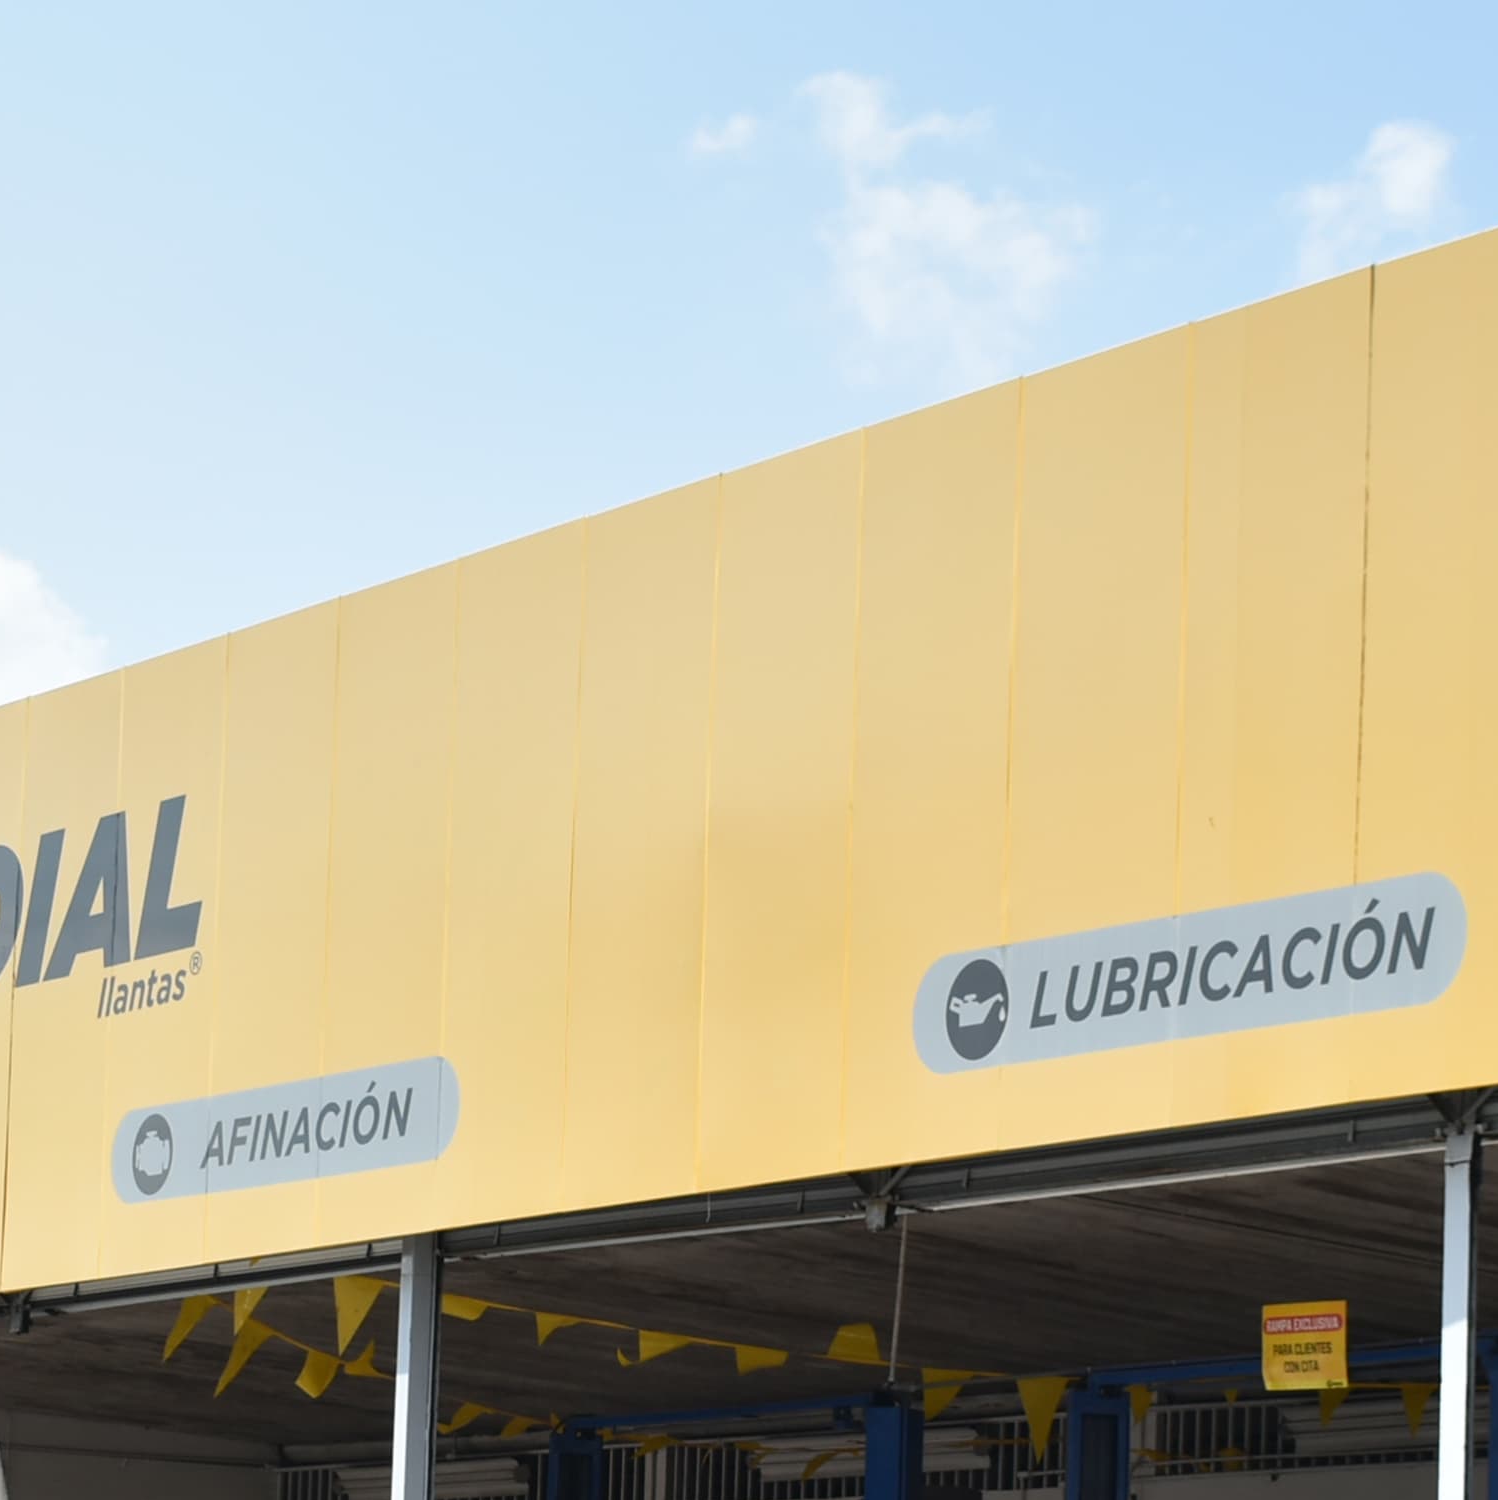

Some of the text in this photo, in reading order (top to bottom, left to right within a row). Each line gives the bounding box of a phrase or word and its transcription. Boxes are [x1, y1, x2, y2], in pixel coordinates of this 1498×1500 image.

[97, 968, 186, 1019] llantas
[1029, 898, 1436, 1029] LUBRICACIÓN
[199, 1080, 413, 1170] AFINACIÓN
[1294, 1341, 1332, 1355] CLIENTES
